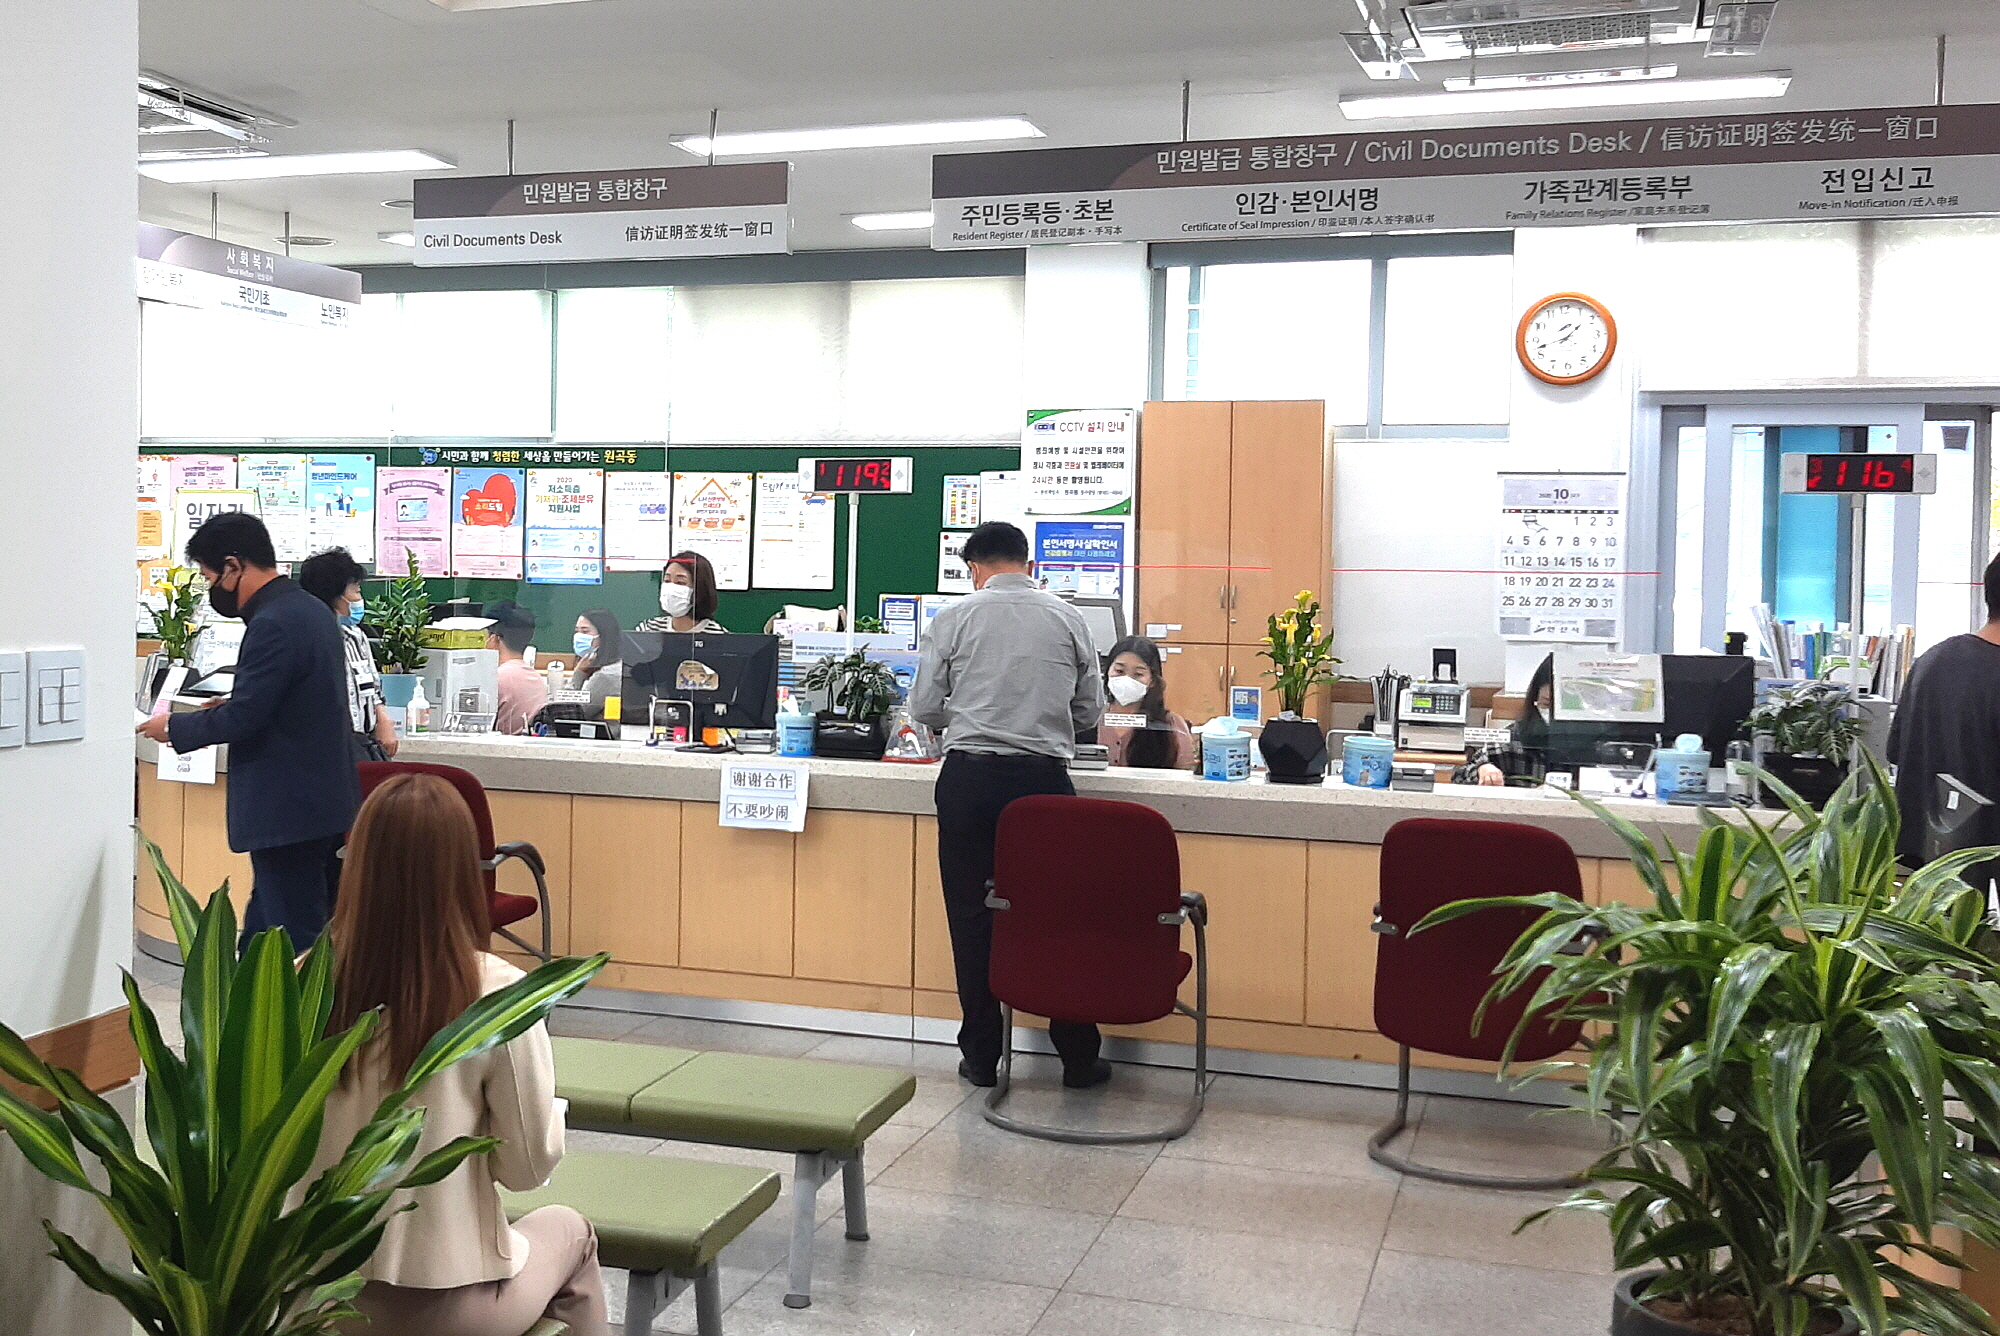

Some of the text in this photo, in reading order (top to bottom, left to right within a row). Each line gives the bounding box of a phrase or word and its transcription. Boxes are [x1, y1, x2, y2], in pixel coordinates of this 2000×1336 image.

[1157, 148, 1242, 174] 민원발급
[1249, 143, 1338, 170] 통합창구
[1364, 140, 1413, 164] Civil
[1421, 136, 1560, 161] Documents
[1568, 131, 1632, 156] Desk
[1659, 115, 1940, 152] 信访证明签发统一窗口
[1820, 166, 1935, 194] 전입신고
[522, 177, 669, 205] 민원발급 통합창구
[1524, 175, 1694, 205] 가족관계등록부
[1235, 187, 1379, 216] 인감·본인서명
[1798, 200, 1842, 210] Move-in
[1844, 198, 1906, 209] Notification
[961, 198, 1115, 227] 주민등록등·초본
[1505, 210, 1538, 222] Family
[1181, 222, 1227, 232] Certificate
[1228, 221, 1239, 231] of
[1239, 220, 1259, 230] Seal
[1260, 219, 1310, 230] Impression
[423, 220, 774, 248] Civil Documents Desk 信访证明签发统一窗口
[952, 232, 988, 241] Resident
[989, 231, 1024, 241] Register
[239, 285, 271, 306] 국민기초
[1059, 421, 1085, 432] CCTV
[1107, 421, 1125, 433] 안내
[441, 450, 469, 462] 시민과
[470, 450, 490, 462] 함께
[492, 450, 521, 463] 청렴한
[523, 450, 551, 463] 세상을
[553, 451, 601, 464] 만들어가는
[603, 449, 638, 464] 원곡동
[1553, 488, 1570, 500] 10
[1574, 516, 1614, 527] 1 2 3
[1506, 535, 1617, 547] 4 5 6 7 8 9 10
[1503, 556, 1616, 568] 11 12 13 14 15 16 17
[1503, 576, 1616, 589] 18 19 20 21 22 23 24
[1502, 595, 1614, 609] 25 26 27 28 29 30 31
[732, 771, 794, 790] 谢谢合作
[726, 802, 789, 821] 不要吵闹
